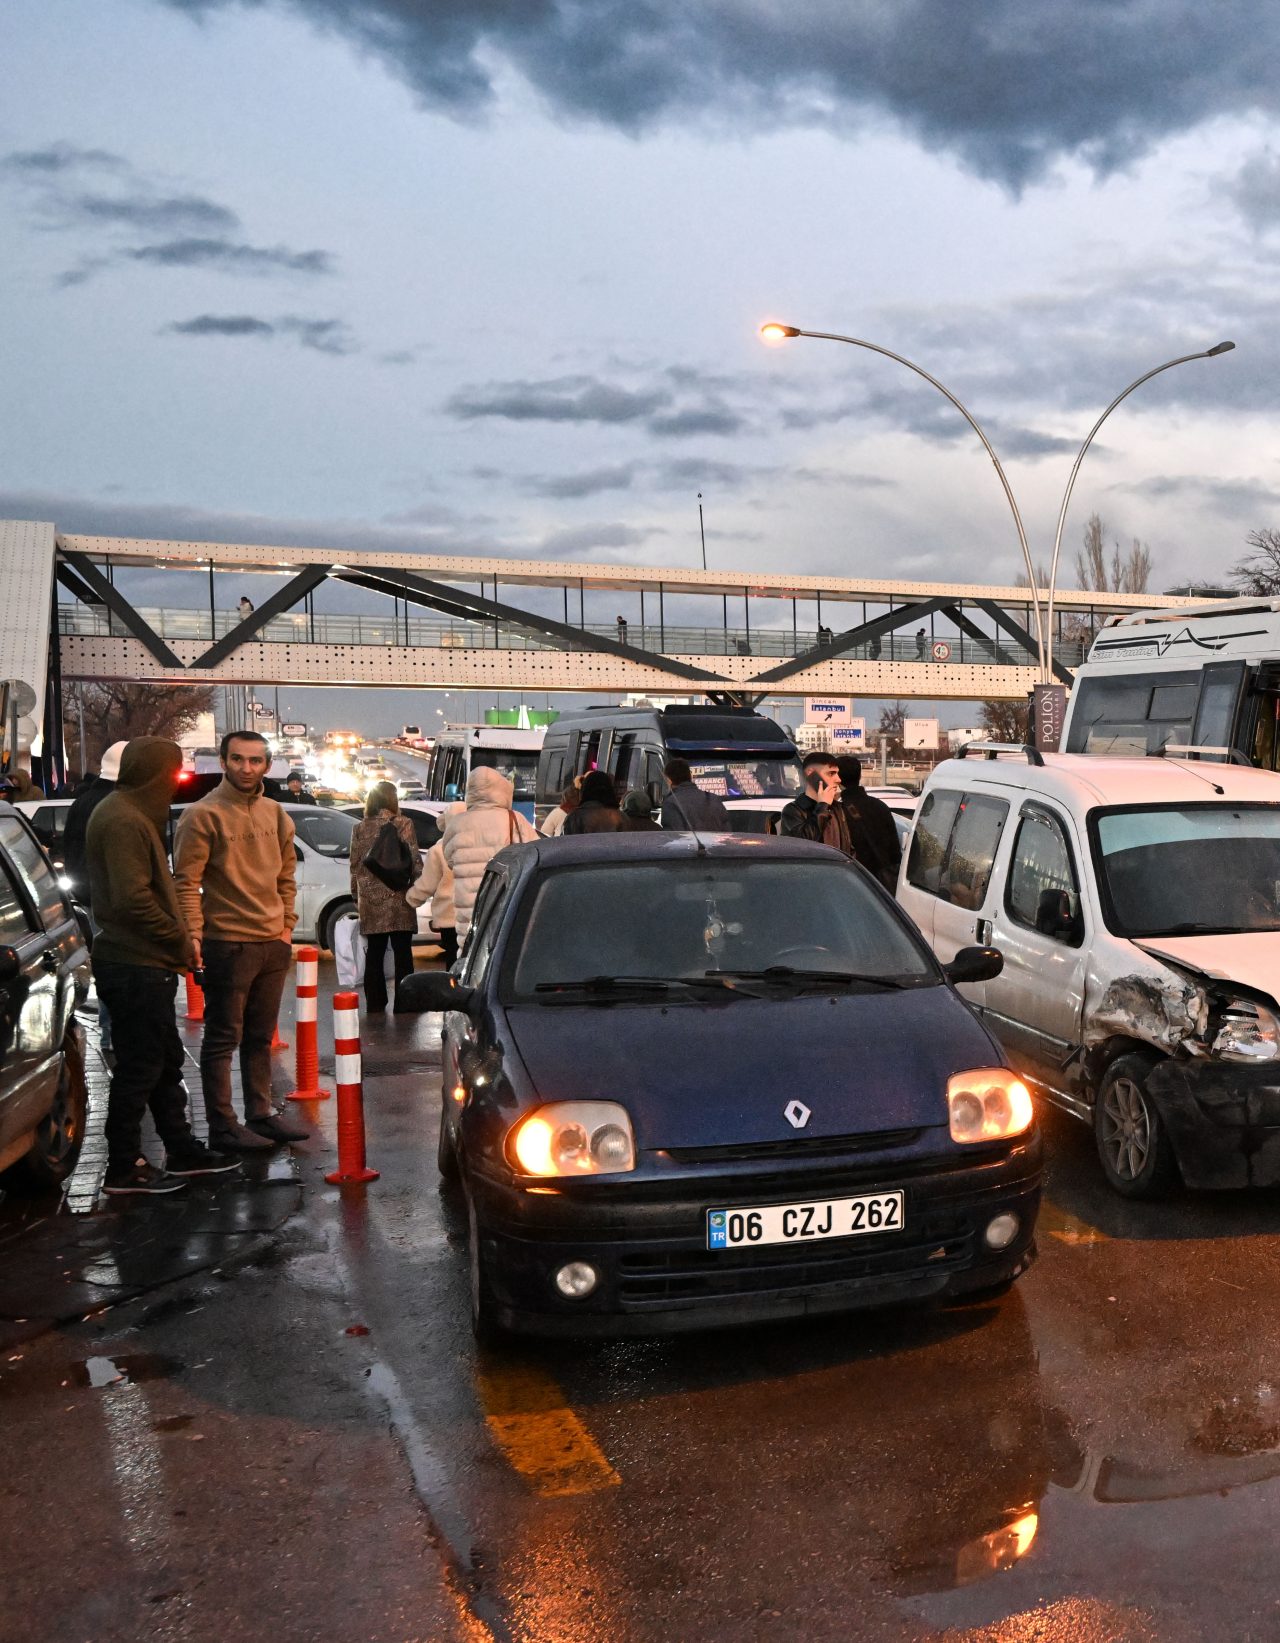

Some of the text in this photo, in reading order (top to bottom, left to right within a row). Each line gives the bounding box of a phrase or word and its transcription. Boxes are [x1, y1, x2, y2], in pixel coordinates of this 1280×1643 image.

[712, 1197, 899, 1243] TR 06 CZJ 262
